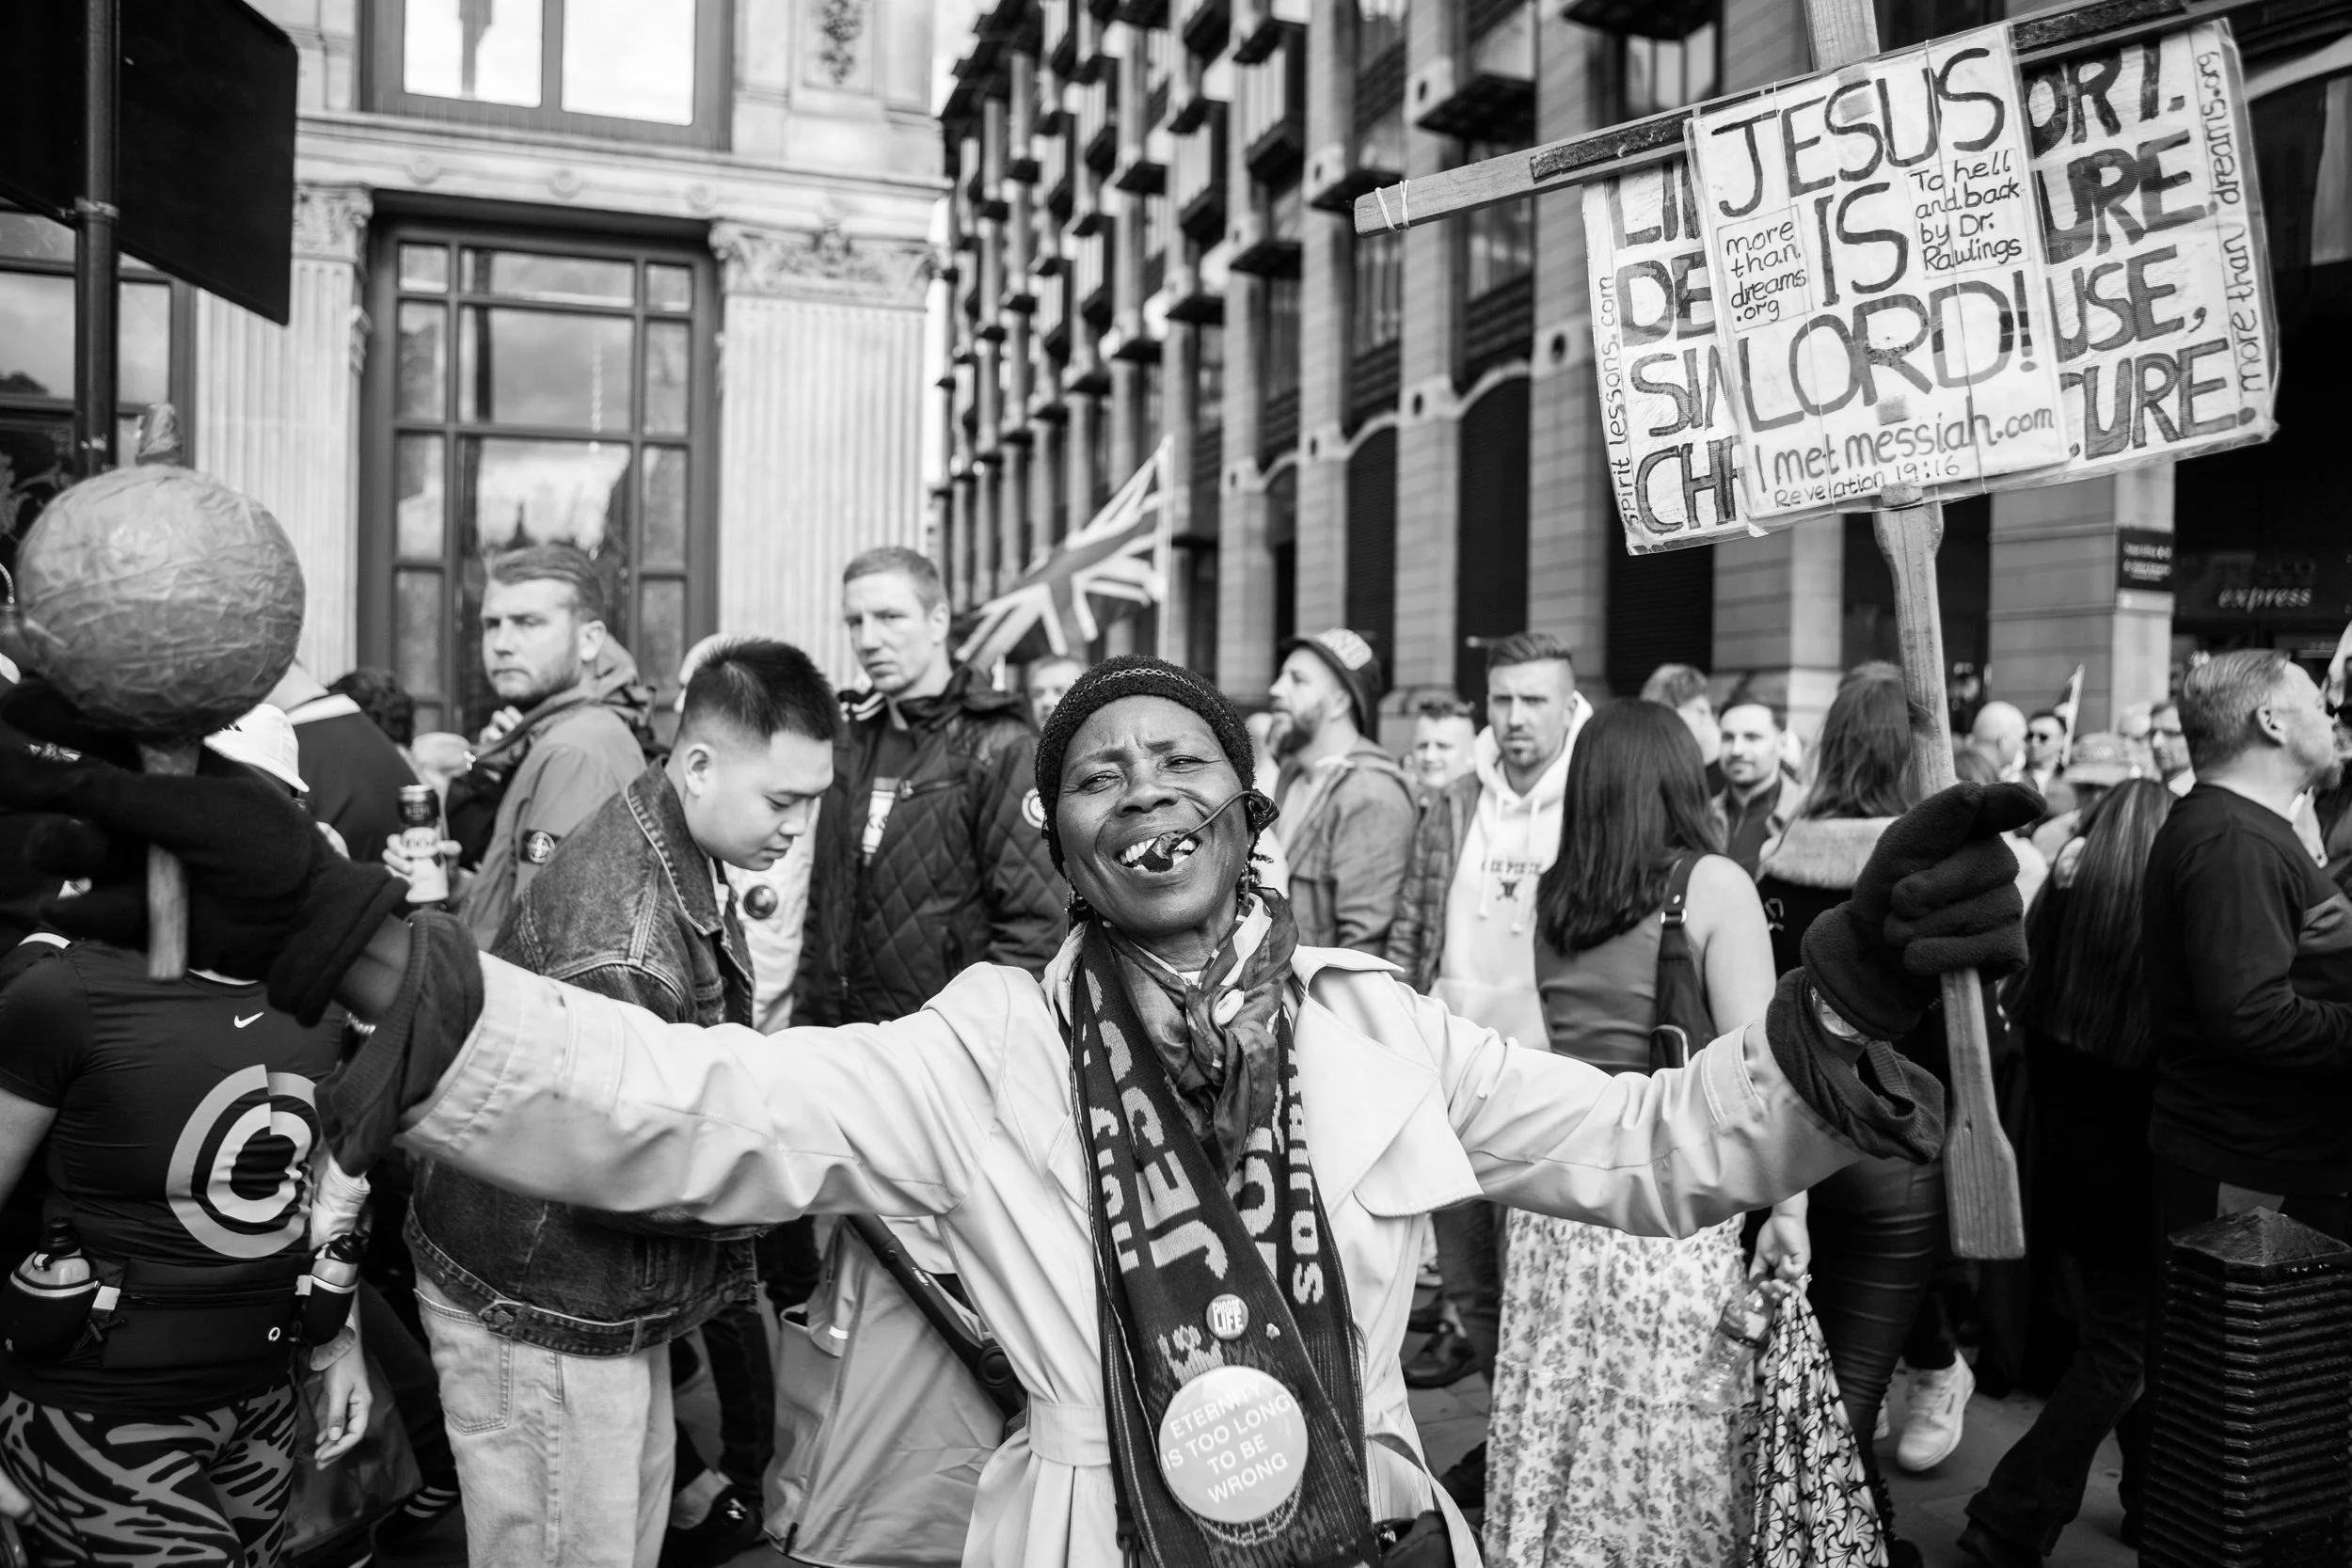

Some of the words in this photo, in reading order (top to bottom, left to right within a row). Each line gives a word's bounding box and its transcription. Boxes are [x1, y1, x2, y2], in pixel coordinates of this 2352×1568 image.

[1712, 48, 2005, 217] JESUS
[1910, 171, 1943, 192] To
[1953, 150, 2011, 182] hell
[2036, 129, 2218, 264] URE.
[1915, 191, 1961, 219] and
[1964, 179, 2020, 208] back
[1726, 221, 1794, 256] more
[1814, 182, 1909, 306] IS
[1920, 218, 1949, 245] by
[1960, 212, 1994, 236] Dr.
[1731, 244, 1801, 278] than
[1922, 239, 2022, 271] Rawlings
[2223, 228, 2258, 304] than
[1614, 250, 1717, 347] DE
[1731, 269, 1806, 309] dreams
[1737, 299, 1779, 322] .org
[2046, 244, 2207, 363] USE,
[1738, 271, 2039, 432] LORD!
[2230, 309, 2265, 393] more
[2060, 338, 2256, 461] URE.
[1616, 456, 1639, 529] spirit
[1774, 471, 1884, 508] Revelation
[1896, 455, 1960, 482] 19:16
[2219, 586, 2312, 612] express
[1212, 1299, 1241, 1314] CHOOSE
[1214, 1311, 1244, 1332] LIFE
[1162, 1449, 1184, 1470] IS
[1184, 1424, 1230, 1458] TOO
[1233, 1393, 1292, 1435] LONG
[1207, 1449, 1235, 1475] TO
[1239, 1433, 1267, 1460] BE
[1207, 1452, 1288, 1503] WRONG
